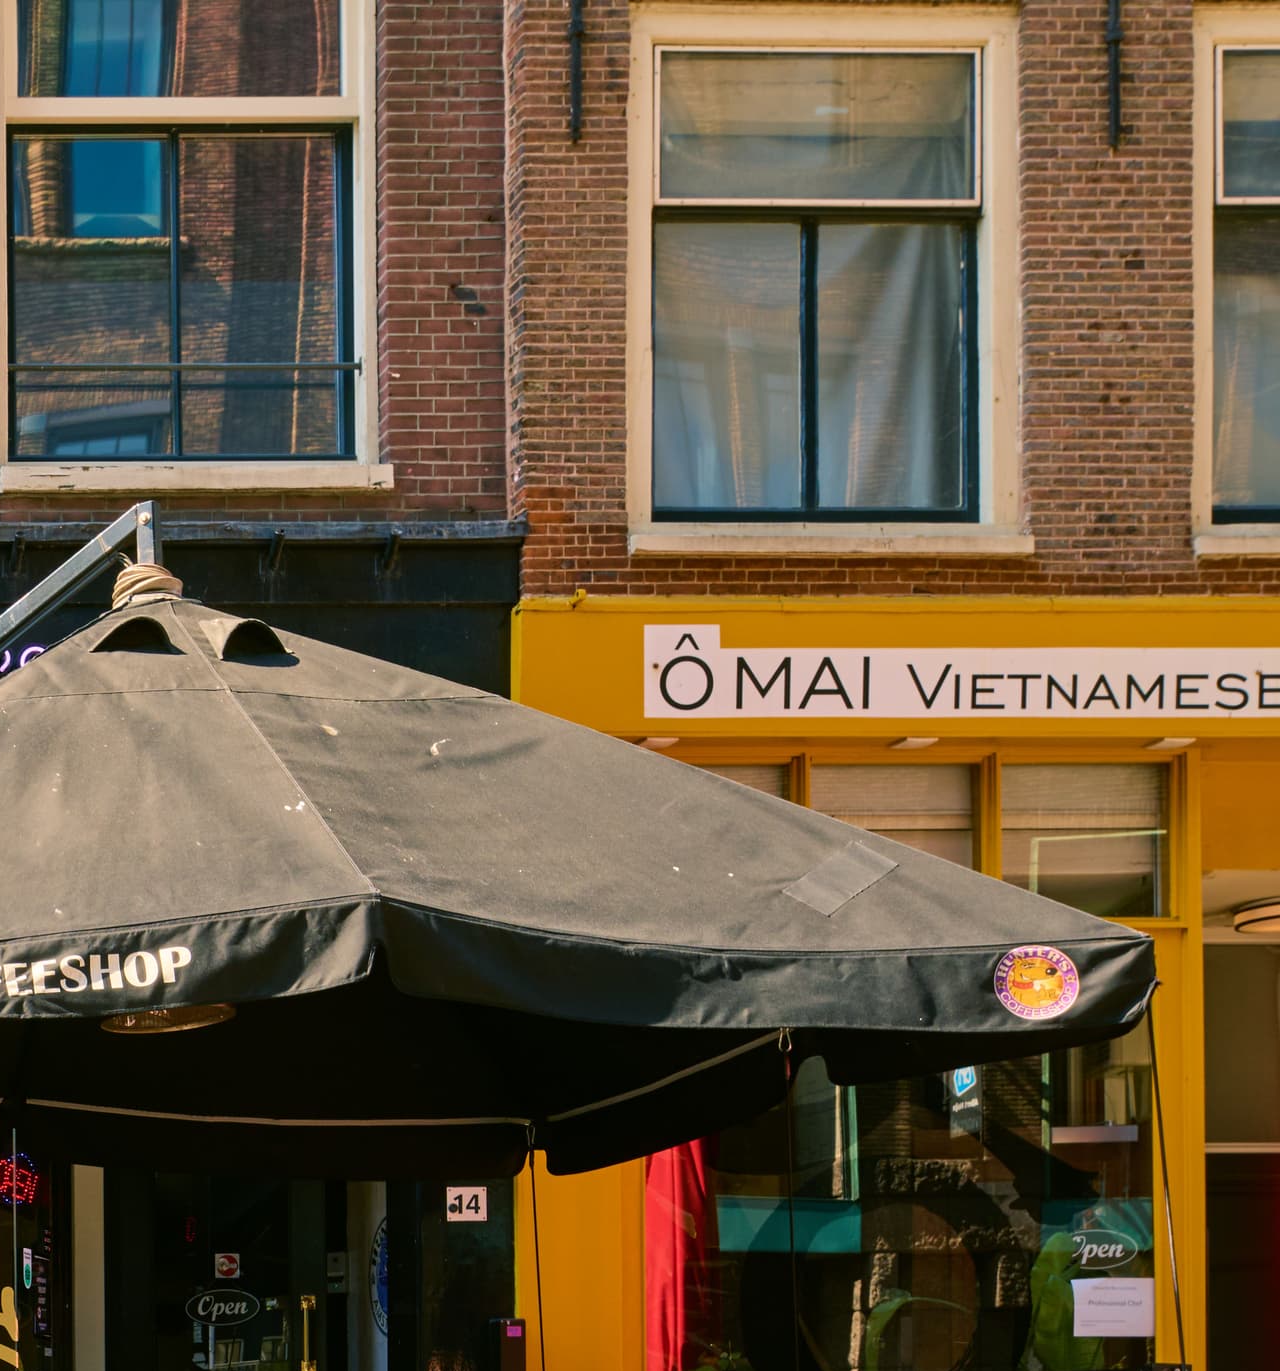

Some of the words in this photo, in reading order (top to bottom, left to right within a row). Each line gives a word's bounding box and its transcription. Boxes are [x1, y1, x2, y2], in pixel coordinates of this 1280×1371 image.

[659, 633, 714, 711] Ô
[736, 656, 871, 710] MAI
[997, 947, 1072, 977] HUNTER'S
[1000, 986, 1073, 1016] COFFEESHOP
[454, 1194, 481, 1214] 14
[197, 1296, 248, 1322] Open
